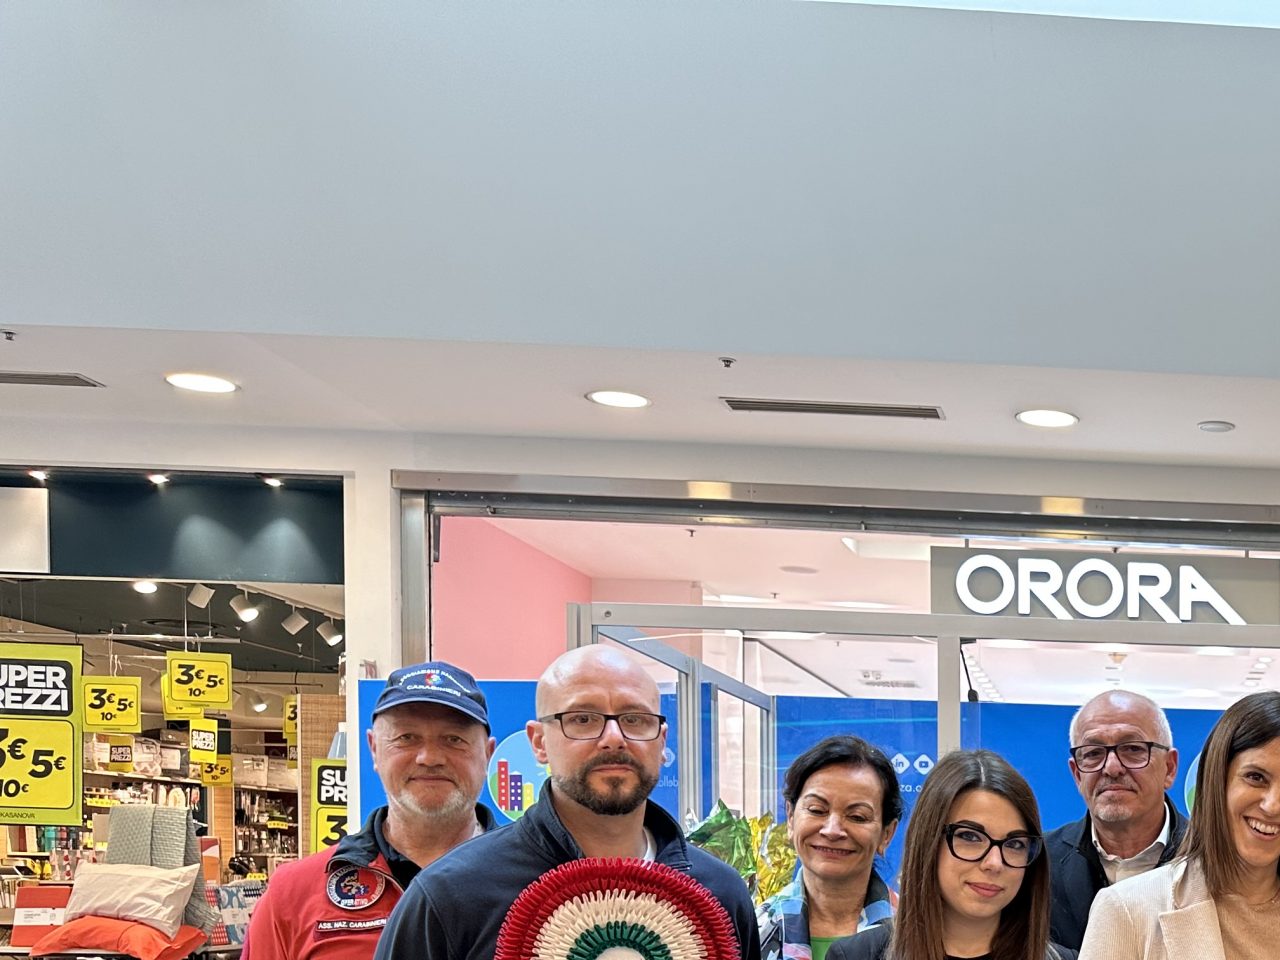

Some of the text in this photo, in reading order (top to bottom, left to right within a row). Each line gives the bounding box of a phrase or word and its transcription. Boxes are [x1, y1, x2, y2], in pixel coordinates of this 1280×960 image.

[956, 554, 1247, 625] ORORA
[175, 664, 225, 689] 3€ 5€
[88, 688, 134, 712] 3€ 5€
[188, 687, 206, 697] 10€
[101, 712, 117, 721] 10€
[28, 749, 67, 778] 5€
